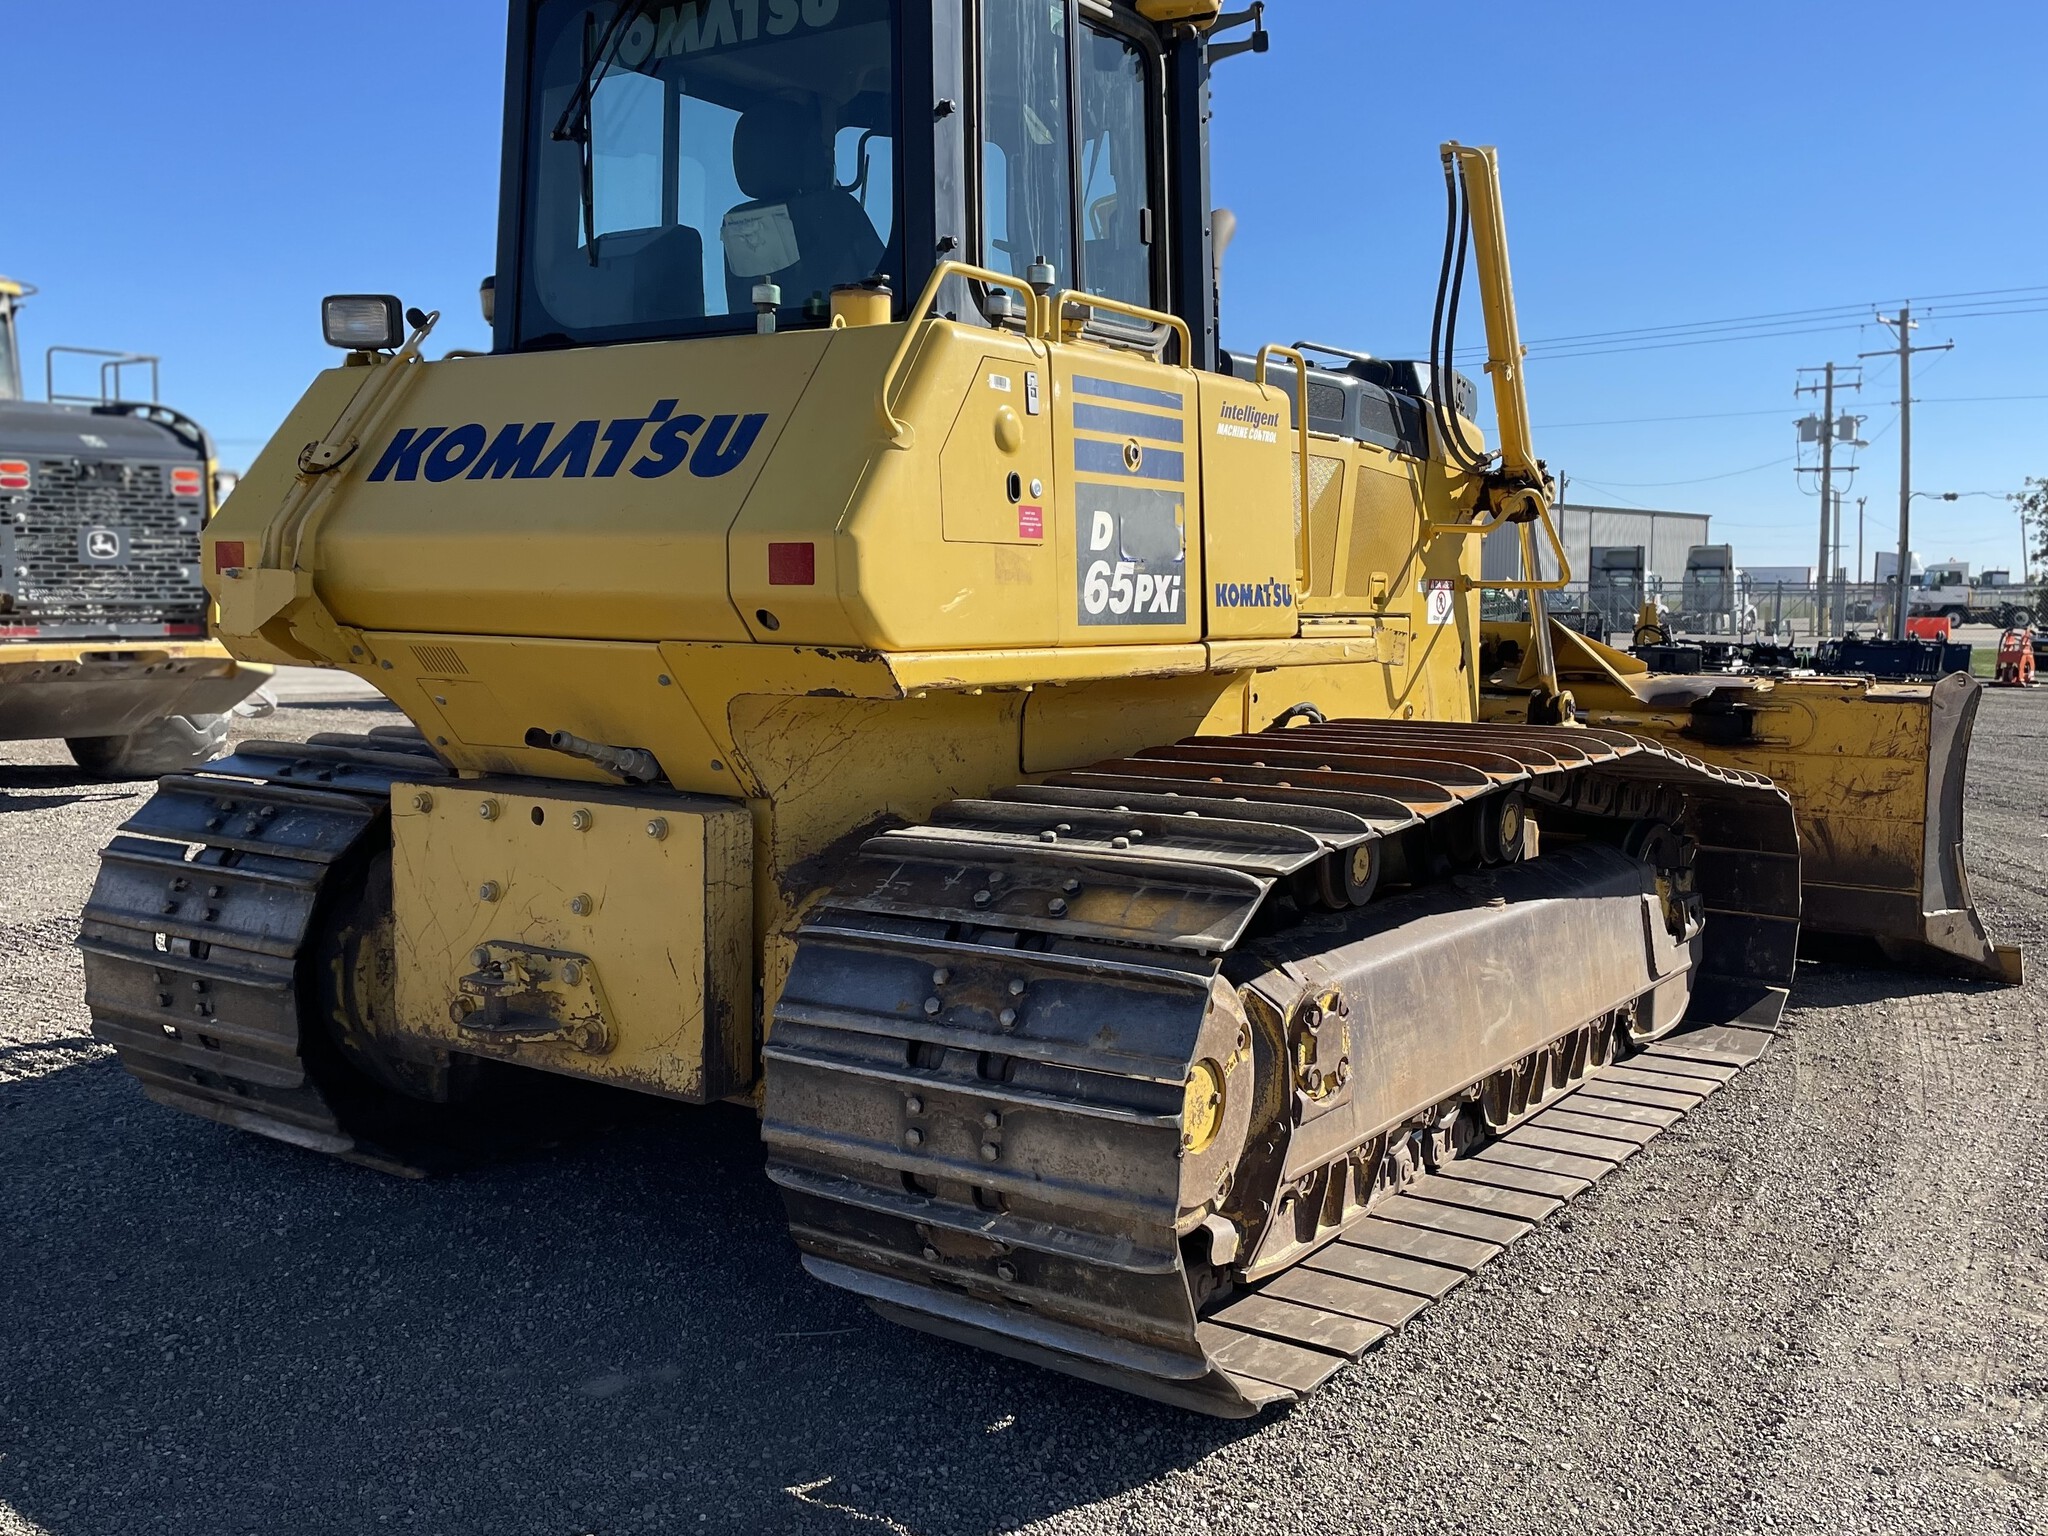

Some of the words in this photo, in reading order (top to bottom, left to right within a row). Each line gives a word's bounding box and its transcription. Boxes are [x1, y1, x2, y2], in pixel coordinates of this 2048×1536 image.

[1220, 401, 1279, 428] intelligent
[367, 399, 769, 482] KOMATSU
[1216, 423, 1249, 439] MACHINE
[1248, 428, 1277, 443] CONTROL
[1090, 511, 1113, 550] D
[1084, 560, 1181, 614] 65PXi
[1215, 577, 1293, 607] KOMATSU
